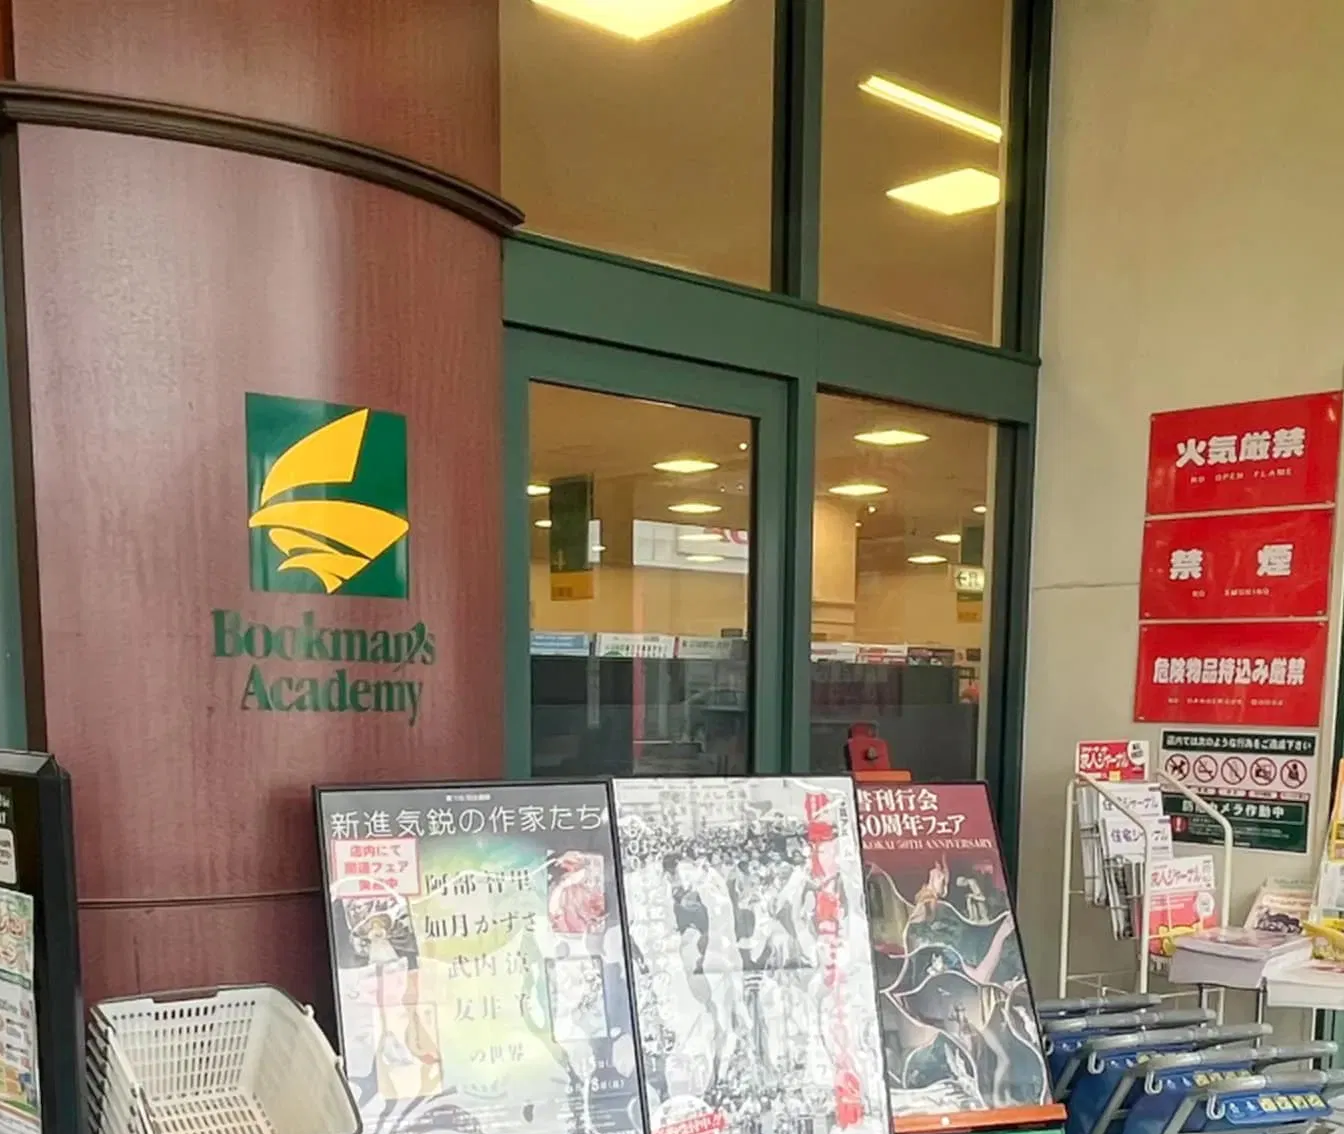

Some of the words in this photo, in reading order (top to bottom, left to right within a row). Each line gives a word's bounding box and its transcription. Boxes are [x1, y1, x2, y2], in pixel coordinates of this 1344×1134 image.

[1175, 426, 1306, 468] 火気厳禁
[1214, 471, 1244, 482] OPEN
[1253, 467, 1292, 478] FLAME
[1153, 656, 1306, 686] 危険物品持込み厳禁
[240, 664, 424, 727] Academy
[330, 804, 602, 838] 新進気鋭の作家たち
